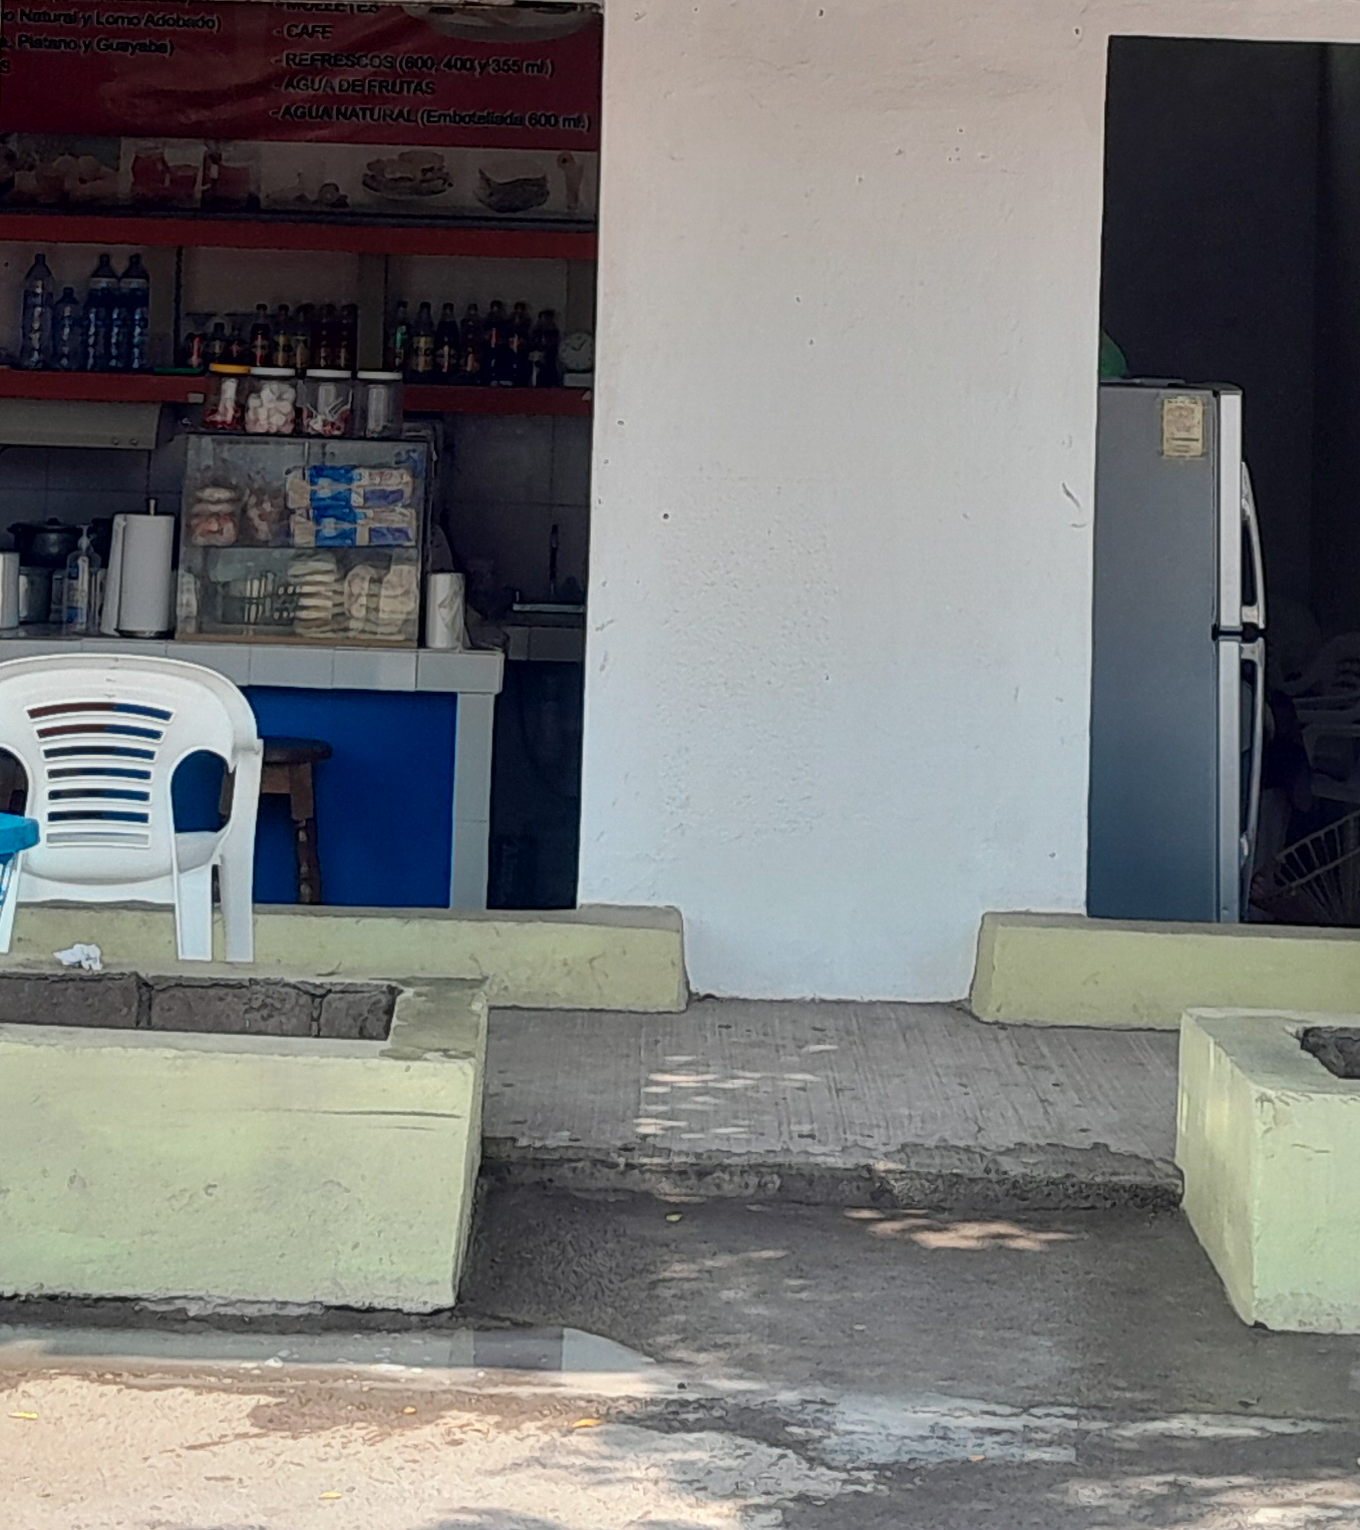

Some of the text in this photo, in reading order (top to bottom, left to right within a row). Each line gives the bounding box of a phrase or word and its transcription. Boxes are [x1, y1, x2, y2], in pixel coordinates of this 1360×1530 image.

[284, 51, 395, 70] REFRESCOS
[283, 76, 437, 96] AGUA DE FRUTAS
